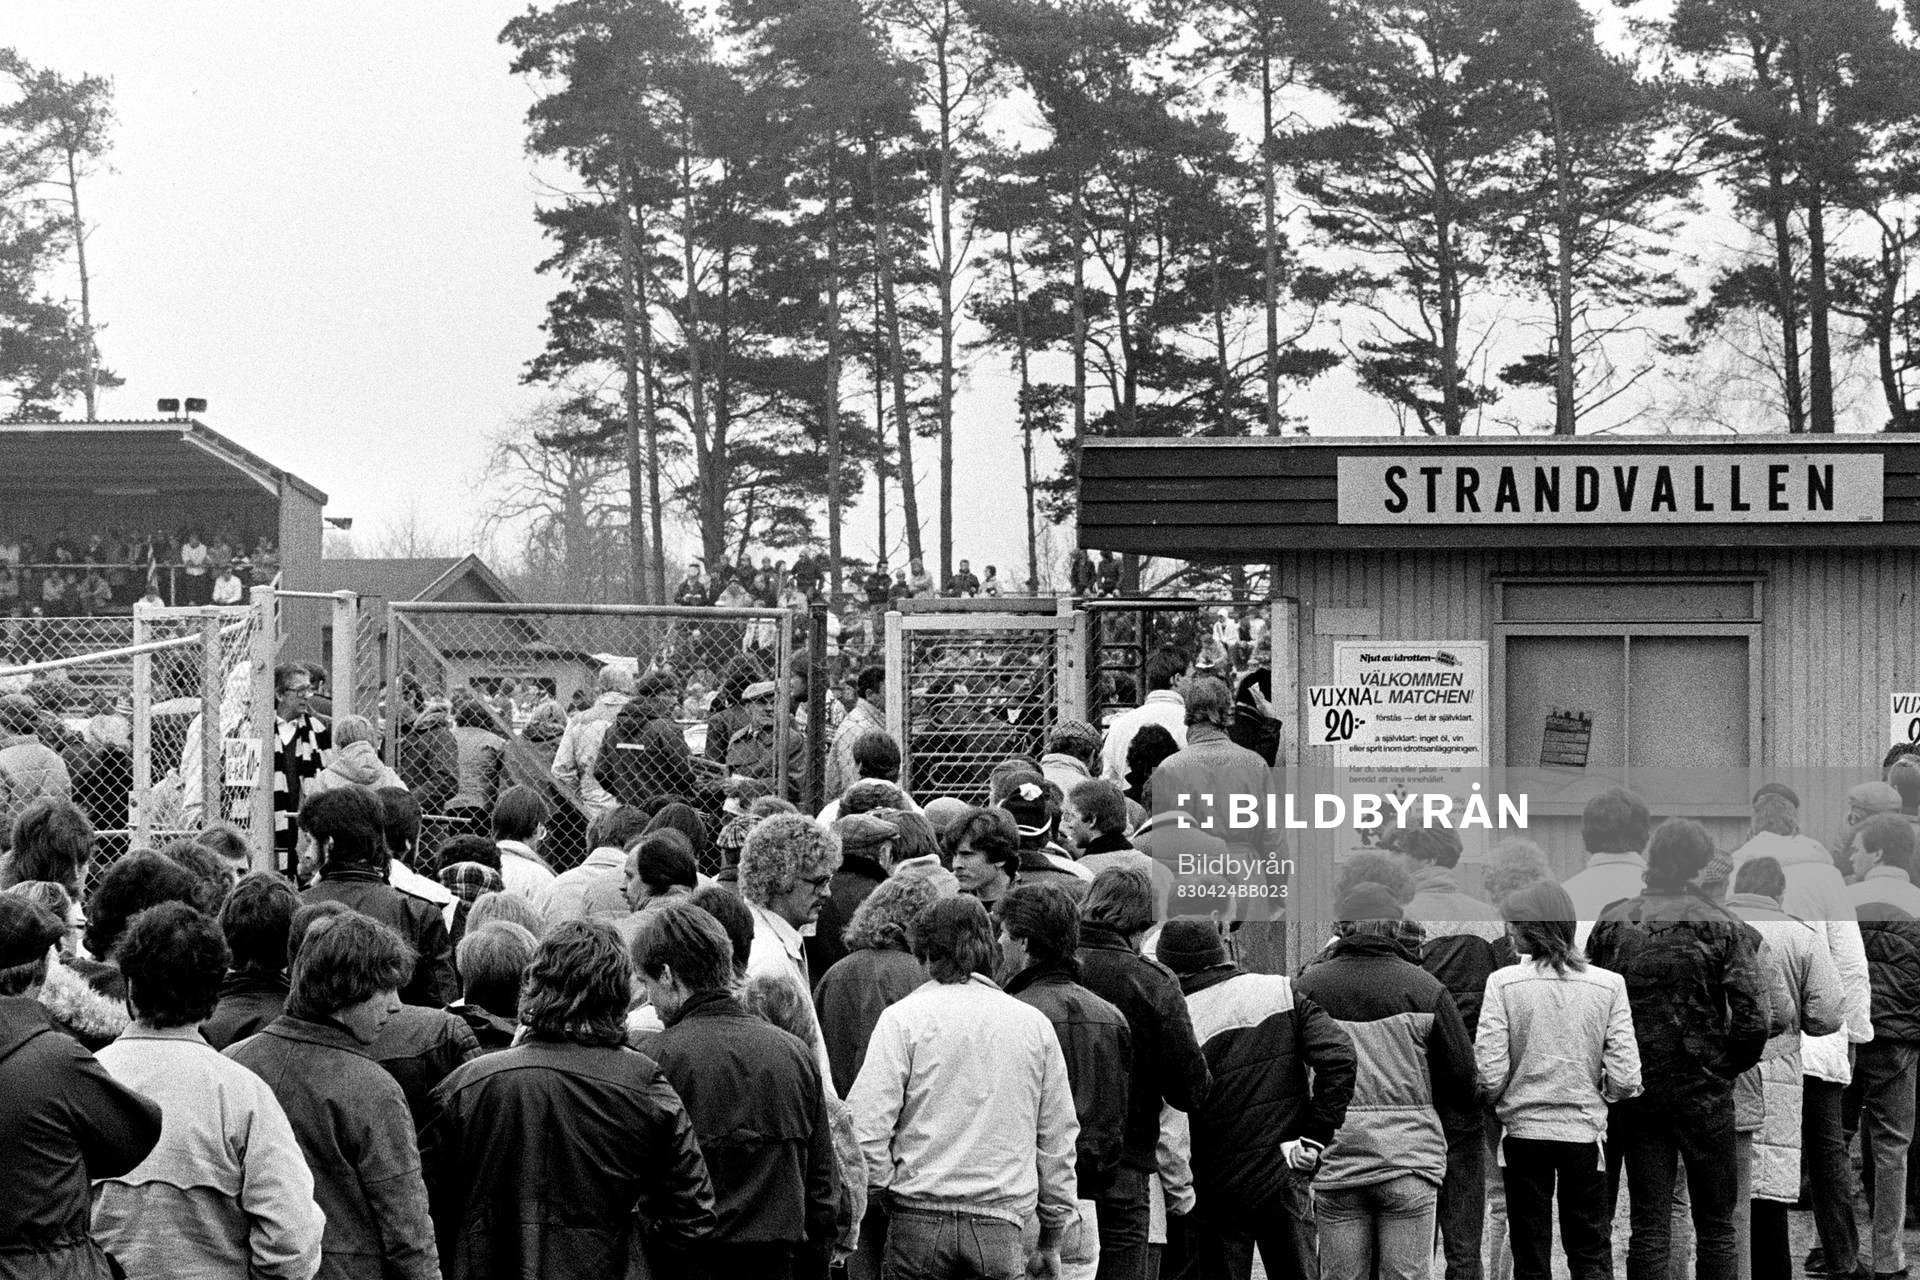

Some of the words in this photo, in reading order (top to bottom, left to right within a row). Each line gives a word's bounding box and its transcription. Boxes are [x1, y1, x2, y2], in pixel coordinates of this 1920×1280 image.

[1384, 464, 1834, 514] STRANDVALLEN
[1359, 653, 1381, 664] Njut
[1359, 669, 1464, 687] VÄLKOMMEN
[1309, 687, 1373, 707] VUXNA
[1388, 689, 1475, 704] MATCHEN!
[1414, 713, 1427, 721] det
[1428, 713, 1437, 721] är
[1325, 708, 1366, 742] 20:-
[1419, 735, 1439, 744] inget
[1349, 744, 1365, 753] eller
[1366, 744, 1383, 755] sprit
[1383, 744, 1402, 753] inom
[1349, 765, 1362, 773] Har
[1364, 765, 1375, 773] du
[1400, 765, 1417, 773] eller
[1348, 775, 1377, 783] beredd
